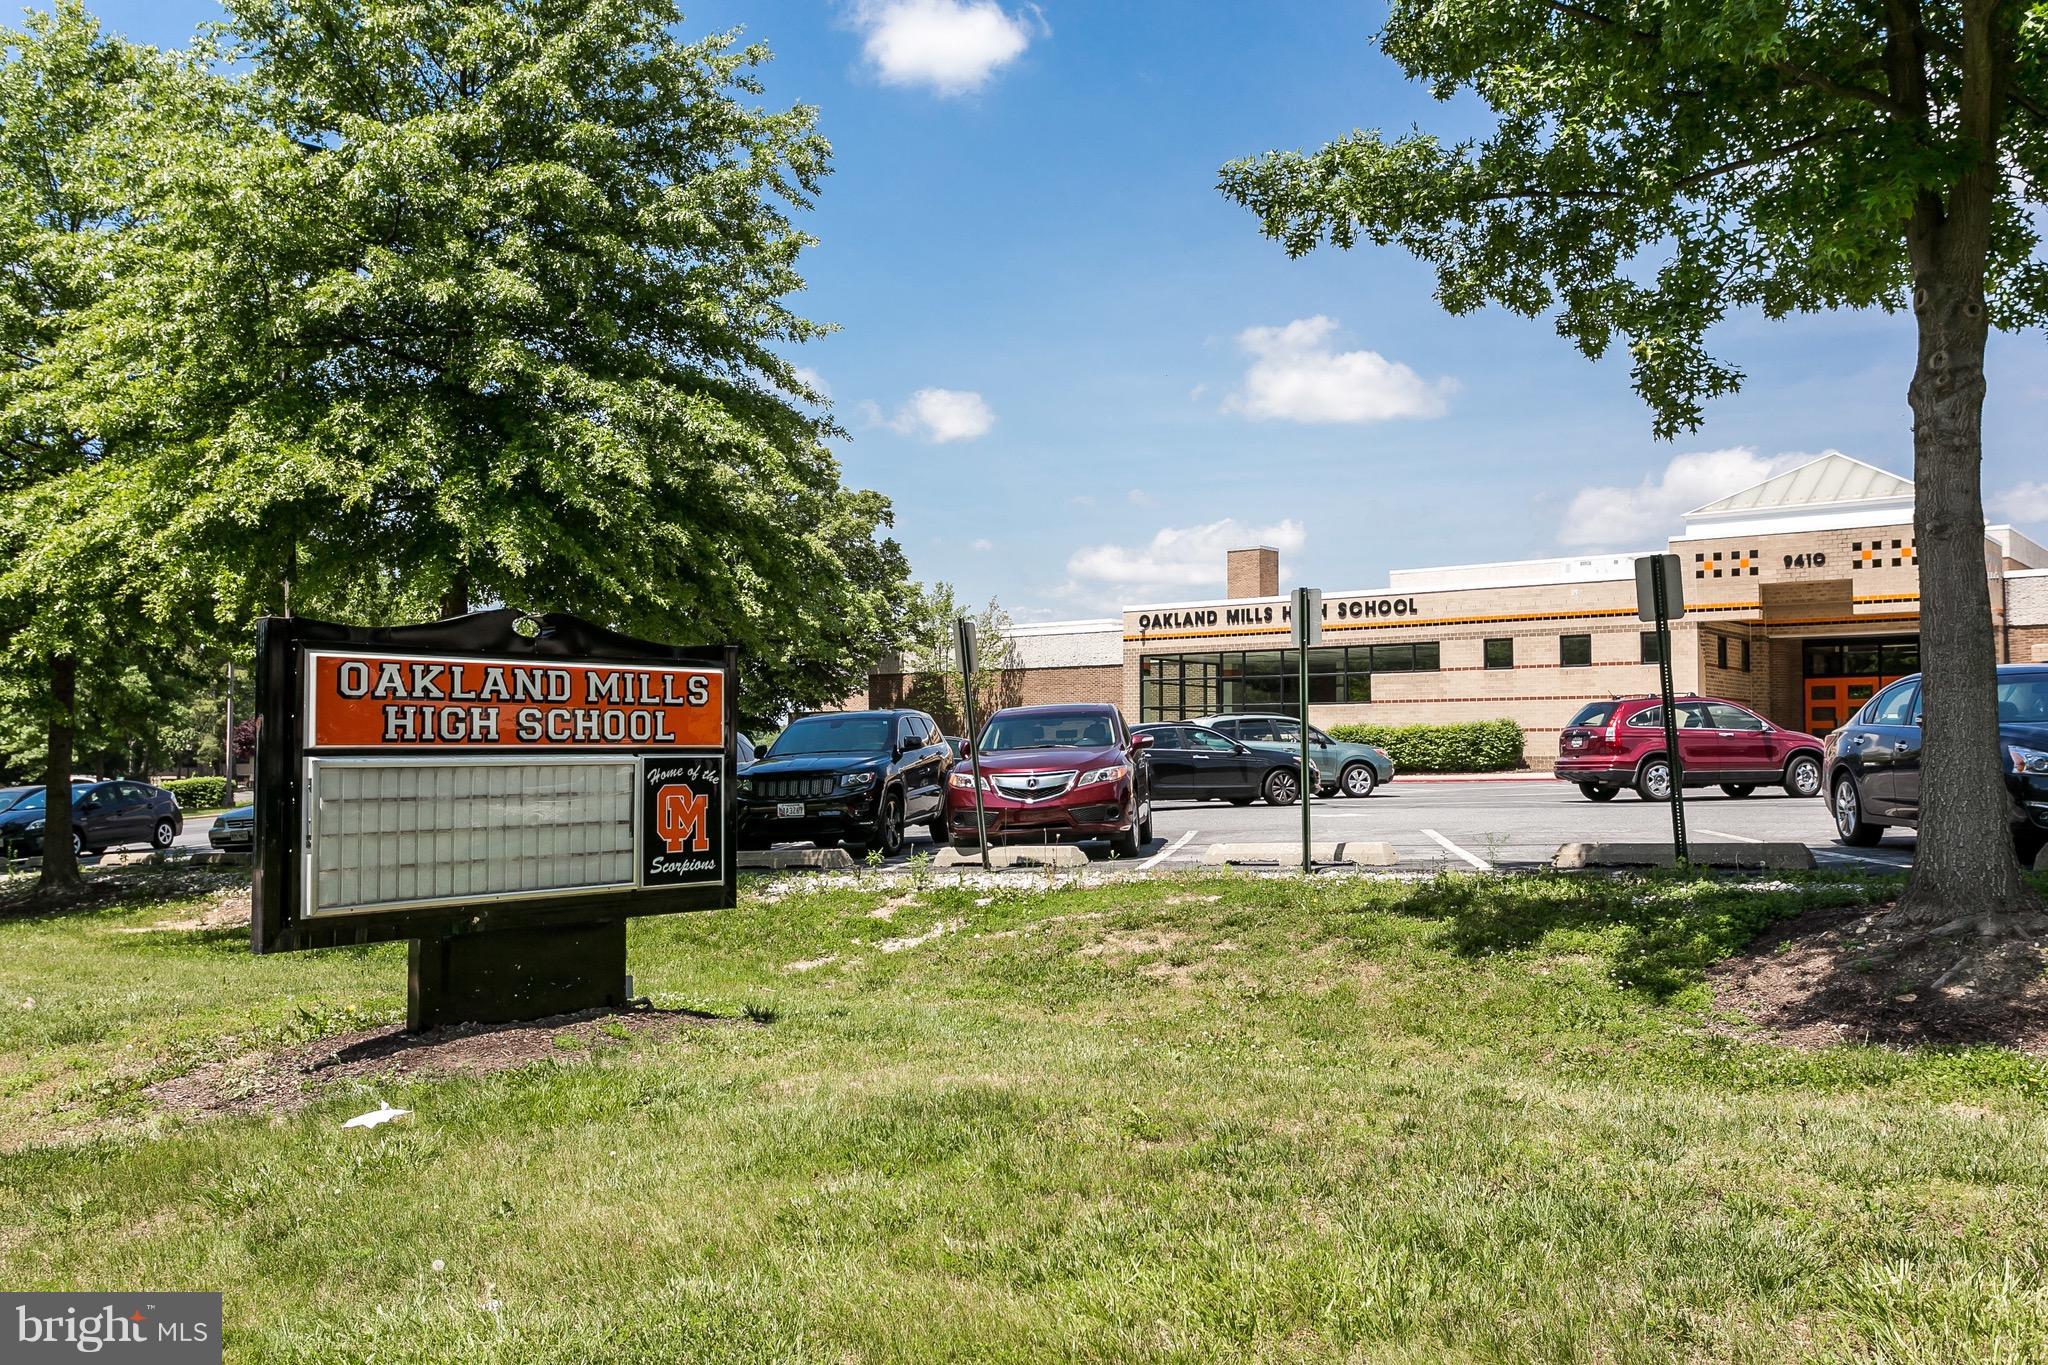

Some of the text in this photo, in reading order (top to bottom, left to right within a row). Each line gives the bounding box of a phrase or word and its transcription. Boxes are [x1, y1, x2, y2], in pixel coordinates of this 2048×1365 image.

[1784, 553, 1825, 569] 9410
[1139, 598, 1418, 629] OAKLAND MILLS HH SCHOOL
[338, 661, 709, 706] OAKLAND MILLS
[383, 705, 675, 742] HIGH SCHOOL
[647, 765, 719, 786] Home of the
[650, 857, 716, 876] Scorpions
